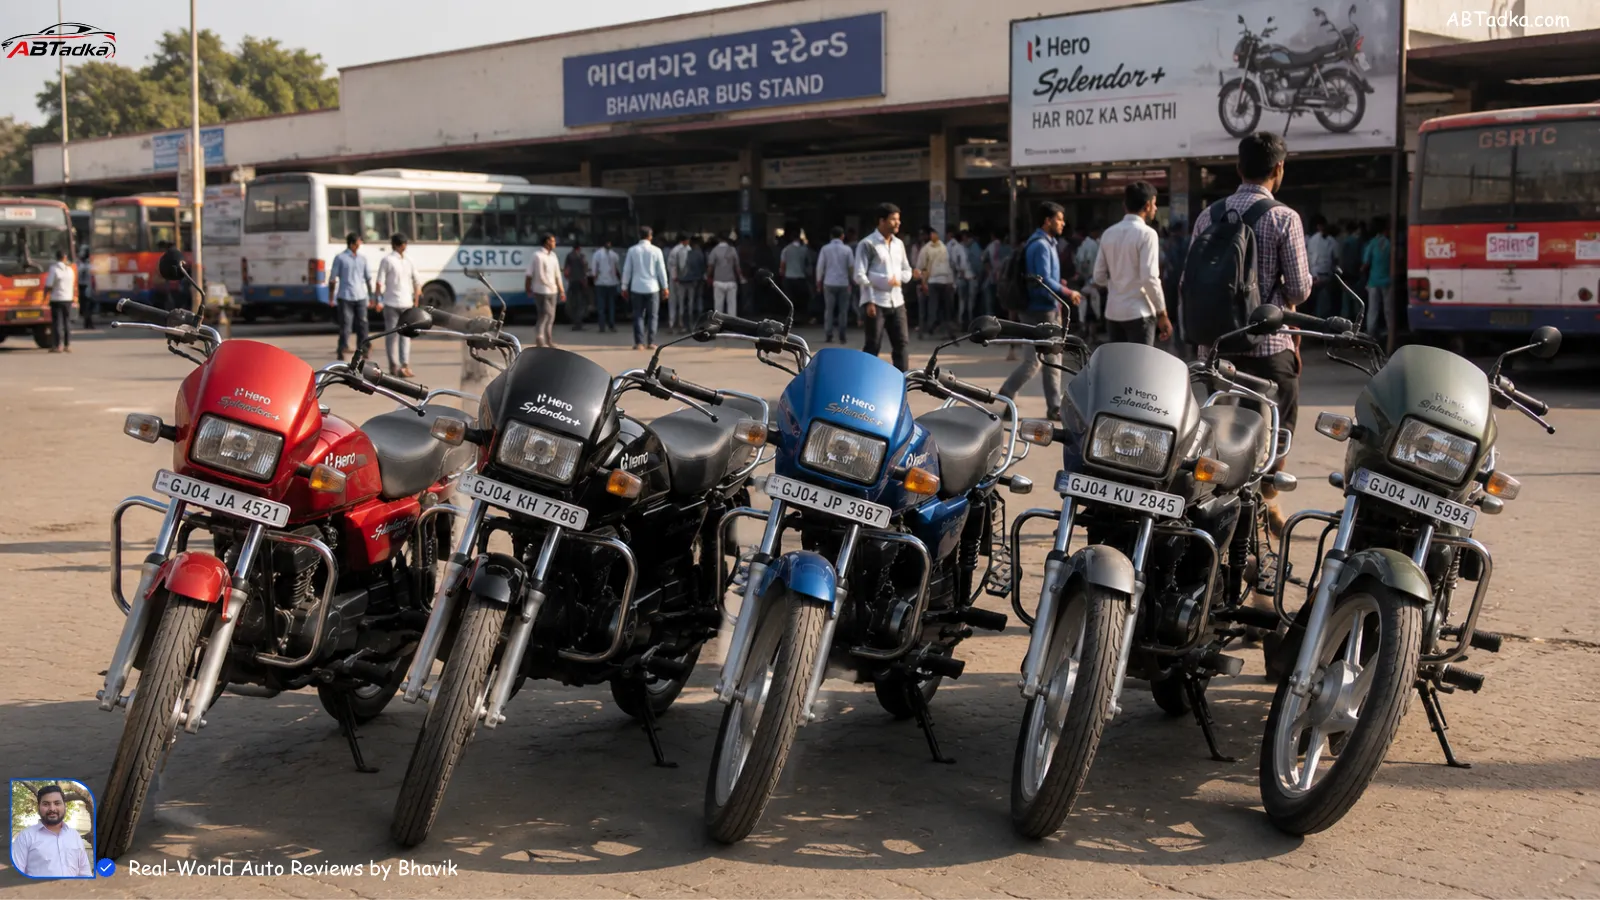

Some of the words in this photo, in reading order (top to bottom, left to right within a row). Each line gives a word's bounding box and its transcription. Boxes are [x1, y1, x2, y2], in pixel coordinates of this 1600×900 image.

[1047, 34, 1090, 58] Hero
[587, 52, 697, 87] ભાવનગર
[708, 43, 758, 72] બસ
[606, 88, 709, 116] BHAVNAGAR
[716, 83, 752, 104] BUS
[759, 74, 824, 99] STAND
[1033, 63, 1166, 102] Splendor+
[1033, 110, 1061, 129] HAR
[1065, 107, 1094, 126] ROZ
[1099, 105, 1119, 124] KA
[1123, 102, 1177, 123] SAATHI
[1478, 127, 1558, 149] GSRTC
[457, 250, 523, 266] GSRTC
[244, 390, 271, 405] Hero
[547, 396, 573, 411] Hero
[851, 397, 876, 412] Hero
[170, 478, 211, 502] GJ04
[215, 493, 236, 509] JA
[241, 499, 280, 521] 4521
[474, 480, 511, 504] GJ04
[517, 492, 539, 512] KH
[544, 501, 579, 525] 7786
[782, 482, 818, 505] GJ04
[823, 494, 842, 513] JP
[846, 502, 883, 523] 3967
[1070, 477, 1107, 499] GJ04
[1114, 488, 1134, 504] KU
[1140, 494, 1176, 513] 2845
[1369, 477, 1406, 500] GJ04
[1410, 492, 1430, 510] JN
